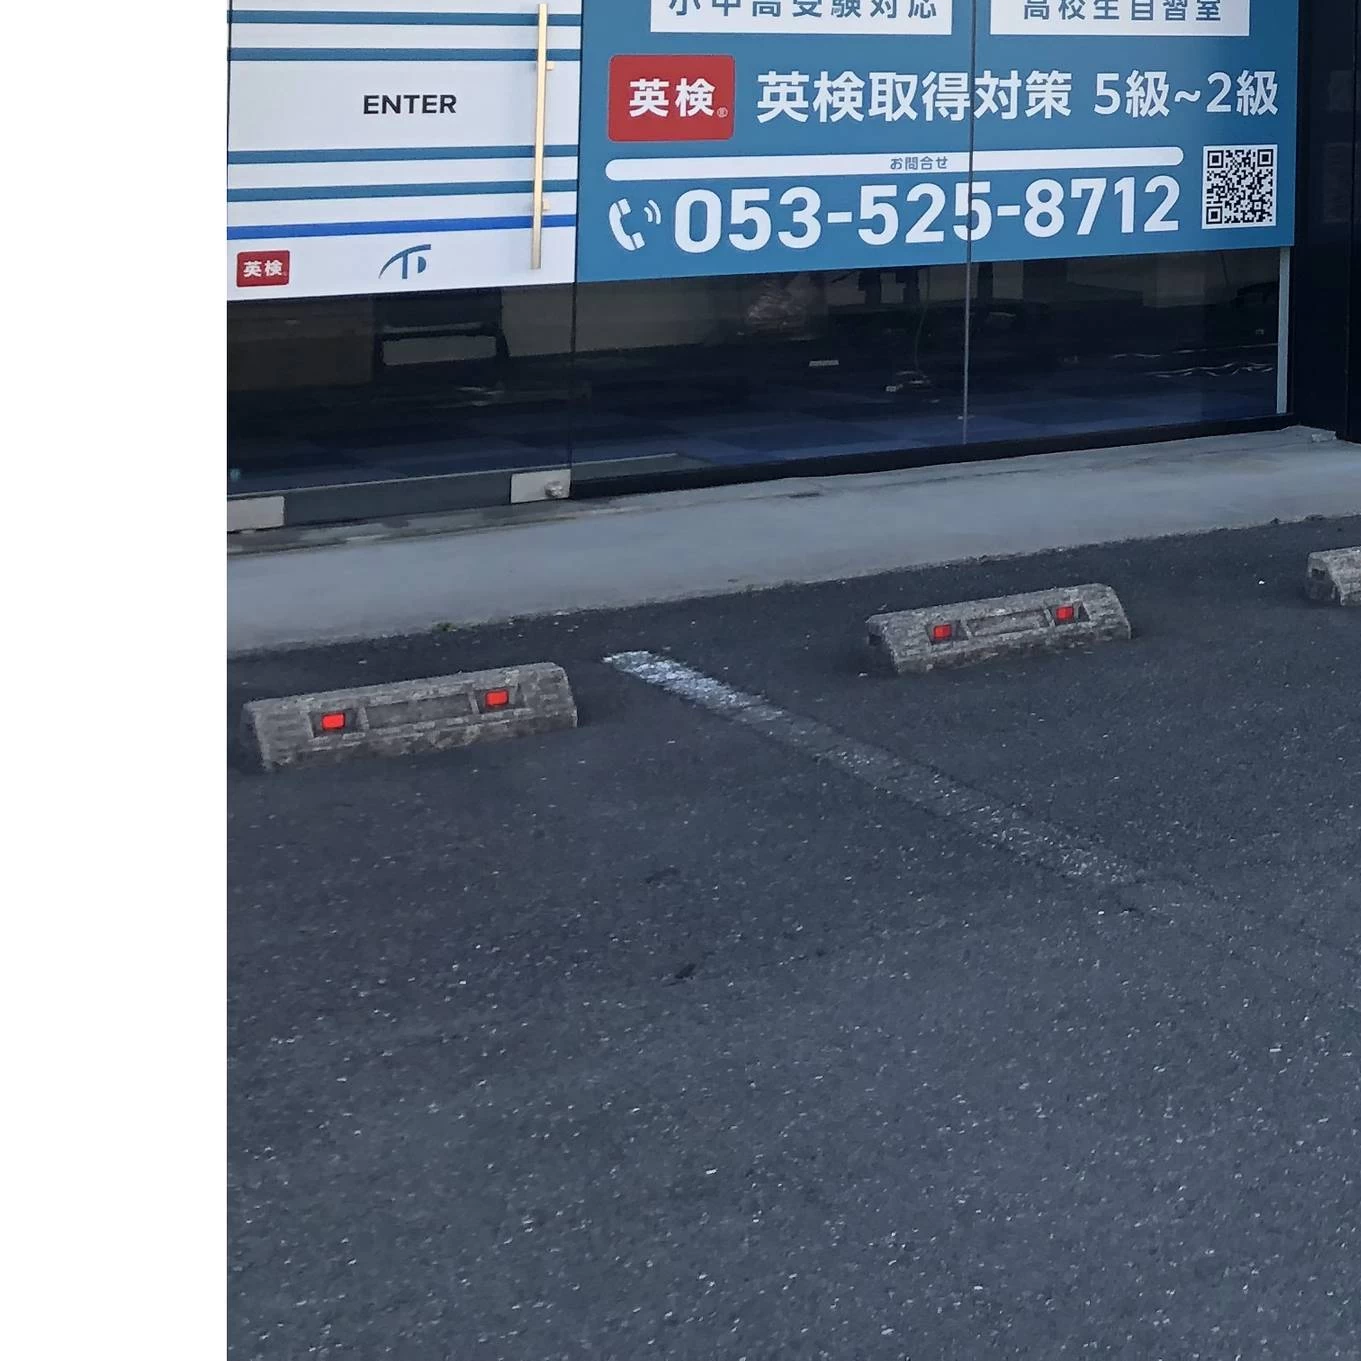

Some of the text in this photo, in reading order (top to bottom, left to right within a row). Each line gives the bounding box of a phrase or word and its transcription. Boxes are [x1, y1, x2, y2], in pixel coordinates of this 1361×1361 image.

[363, 94, 457, 115] ENTER
[756, 71, 1073, 124] 英検取得対策
[889, 154, 949, 172] お問合せ
[673, 175, 1181, 254] 053-525-8712
